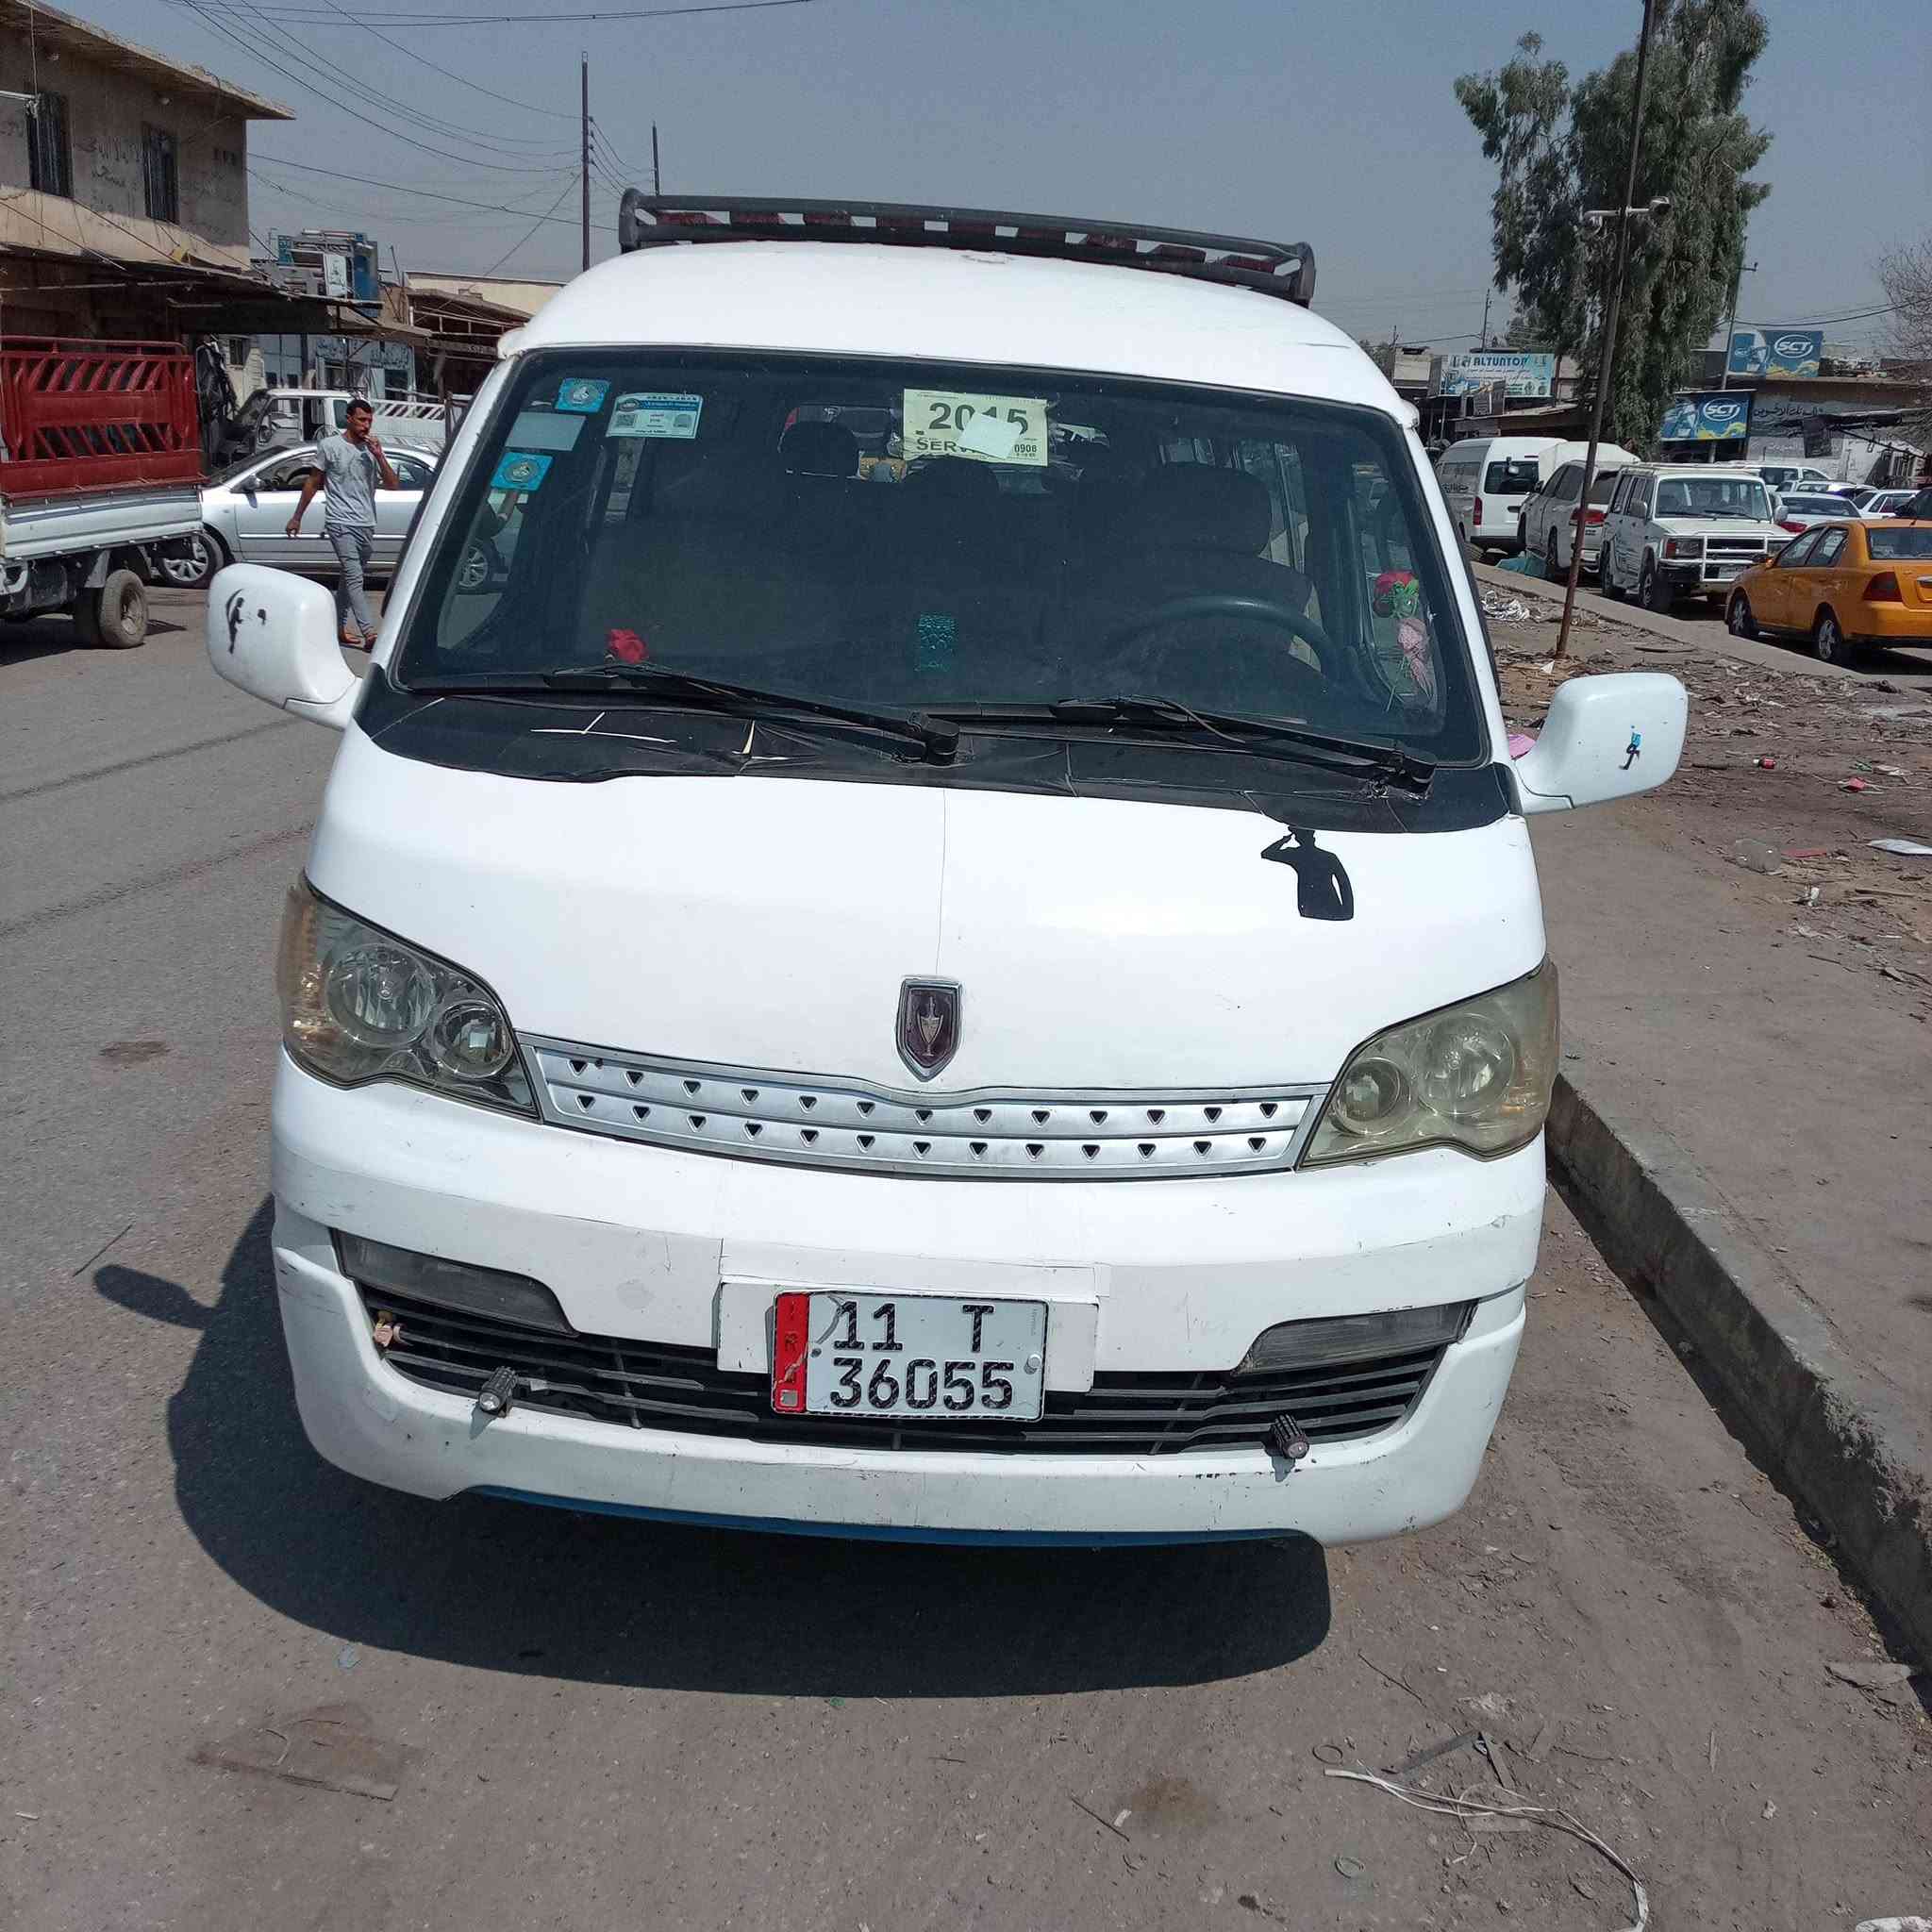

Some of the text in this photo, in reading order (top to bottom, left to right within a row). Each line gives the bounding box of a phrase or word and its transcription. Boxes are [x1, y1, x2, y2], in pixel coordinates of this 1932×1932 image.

[1777, 341, 1811, 352] SCT
[1706, 403, 1740, 416] SCT
[833, 1300, 904, 1352] 11
[961, 1304, 996, 1354] T
[829, 1356, 1015, 1411] 36055
